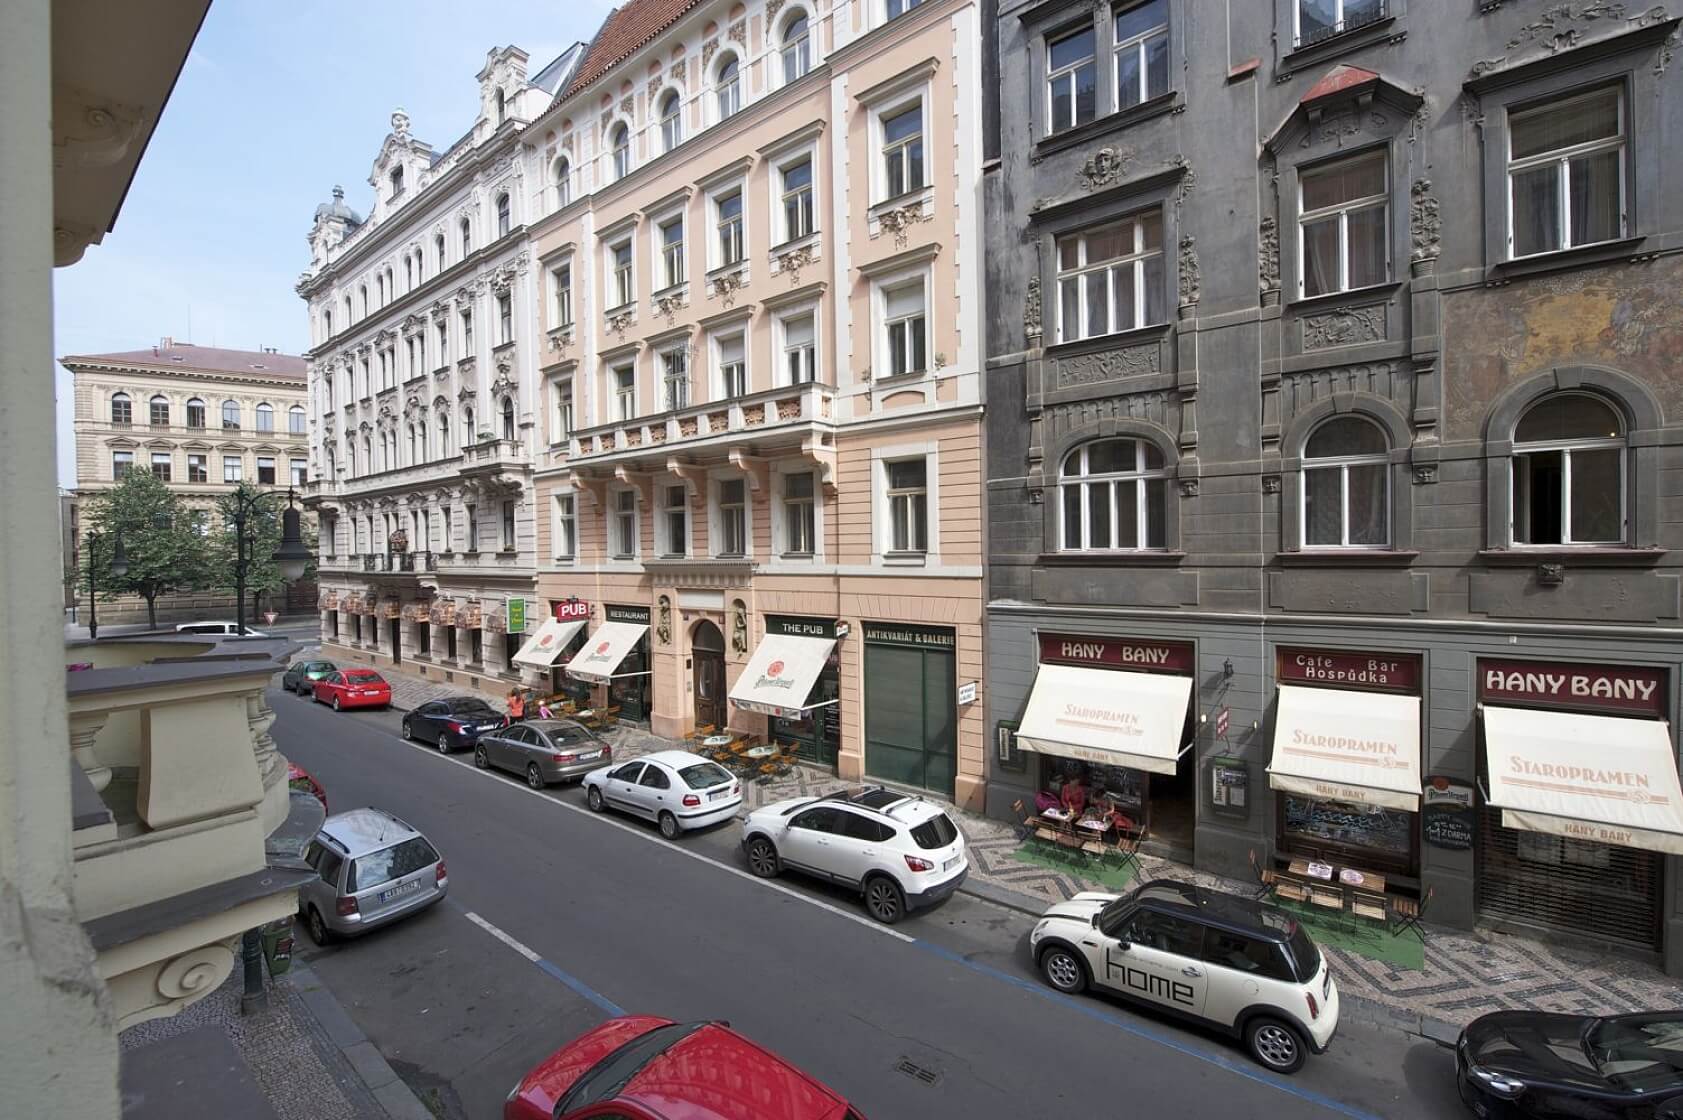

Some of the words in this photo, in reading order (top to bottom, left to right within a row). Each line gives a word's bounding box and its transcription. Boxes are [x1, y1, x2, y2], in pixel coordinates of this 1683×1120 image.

[561, 603, 587, 616] PUB
[610, 609, 649, 620] RESTAURANT
[782, 623, 801, 633] THE
[803, 624, 824, 635] PUB
[1061, 642, 1105, 660] HANY
[1122, 646, 1170, 664] BANY
[1296, 654, 1333, 668] Cafe
[1367, 659, 1398, 672] Bar
[1486, 670, 1566, 694] HANY
[1571, 675, 1657, 701] BANY
[1292, 729, 1398, 755] STAROPRAMEN
[1510, 755, 1650, 788] STAROPRAMEN
[1316, 783, 1339, 796] HANY
[1564, 822, 1597, 836] HANY
[1600, 829, 1633, 843] BANY
[1106, 947, 1195, 1006] home
